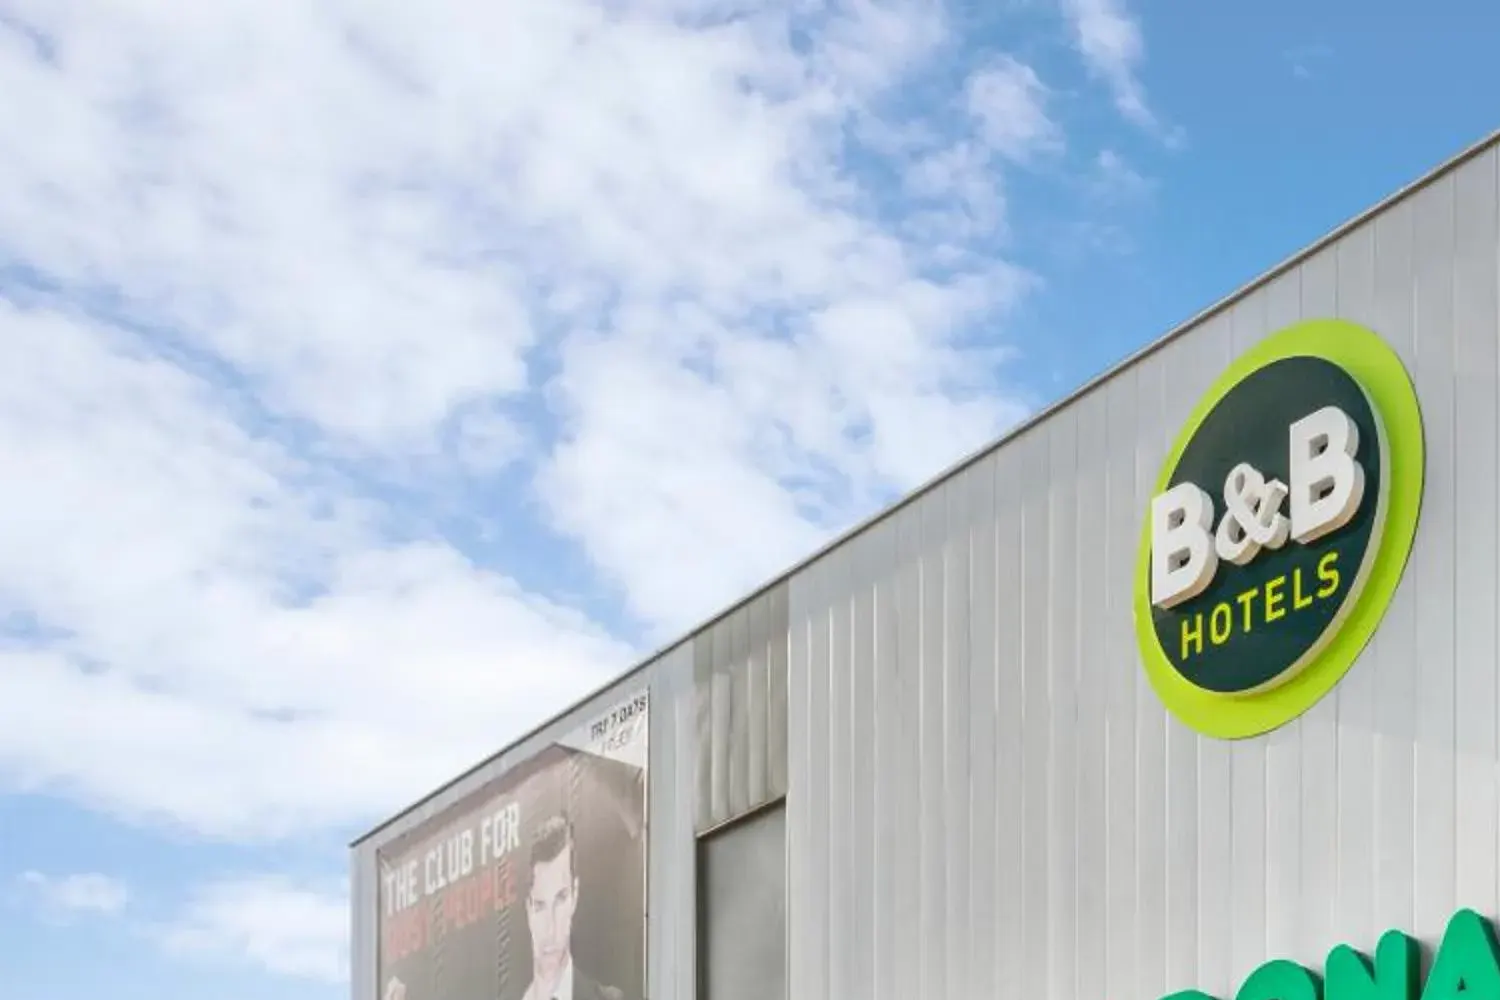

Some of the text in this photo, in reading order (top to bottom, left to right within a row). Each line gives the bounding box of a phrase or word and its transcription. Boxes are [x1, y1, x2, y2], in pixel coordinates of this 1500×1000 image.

[1151, 405, 1366, 610] B&B
[1180, 551, 1342, 661] HOTELS
[383, 801, 521, 918] THE CLUB FOR
